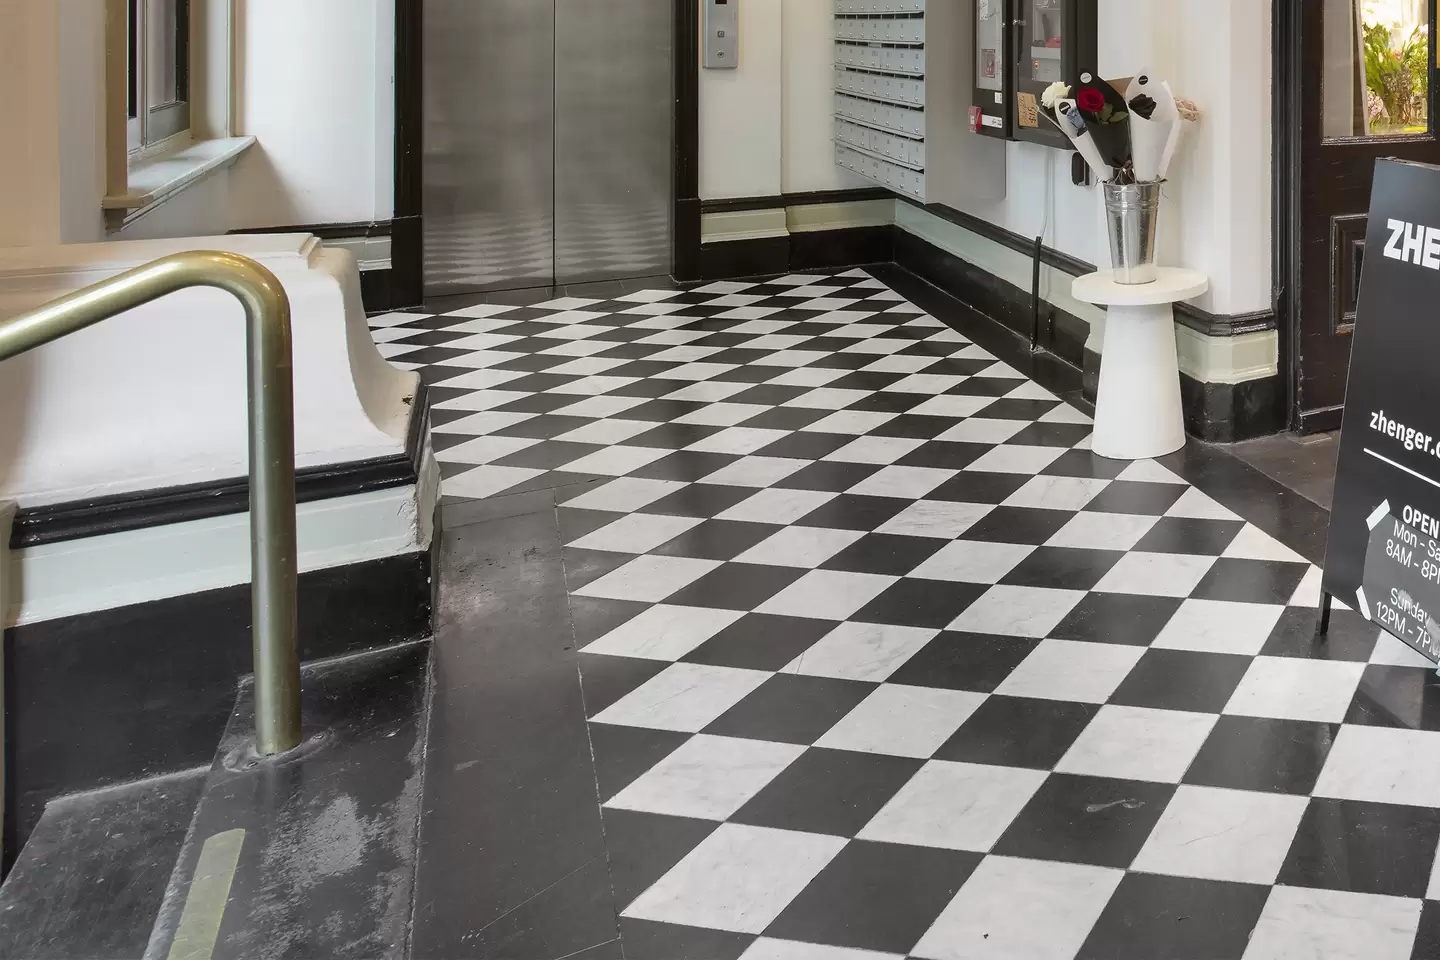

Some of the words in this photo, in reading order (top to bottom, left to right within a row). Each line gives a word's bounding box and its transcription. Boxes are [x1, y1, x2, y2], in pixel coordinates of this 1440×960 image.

[1393, 520, 1417, 548] Mon
[1402, 505, 1440, 539] OPEN
[1385, 539, 1412, 568] 8AM
[1376, 601, 1406, 635] 12PM
